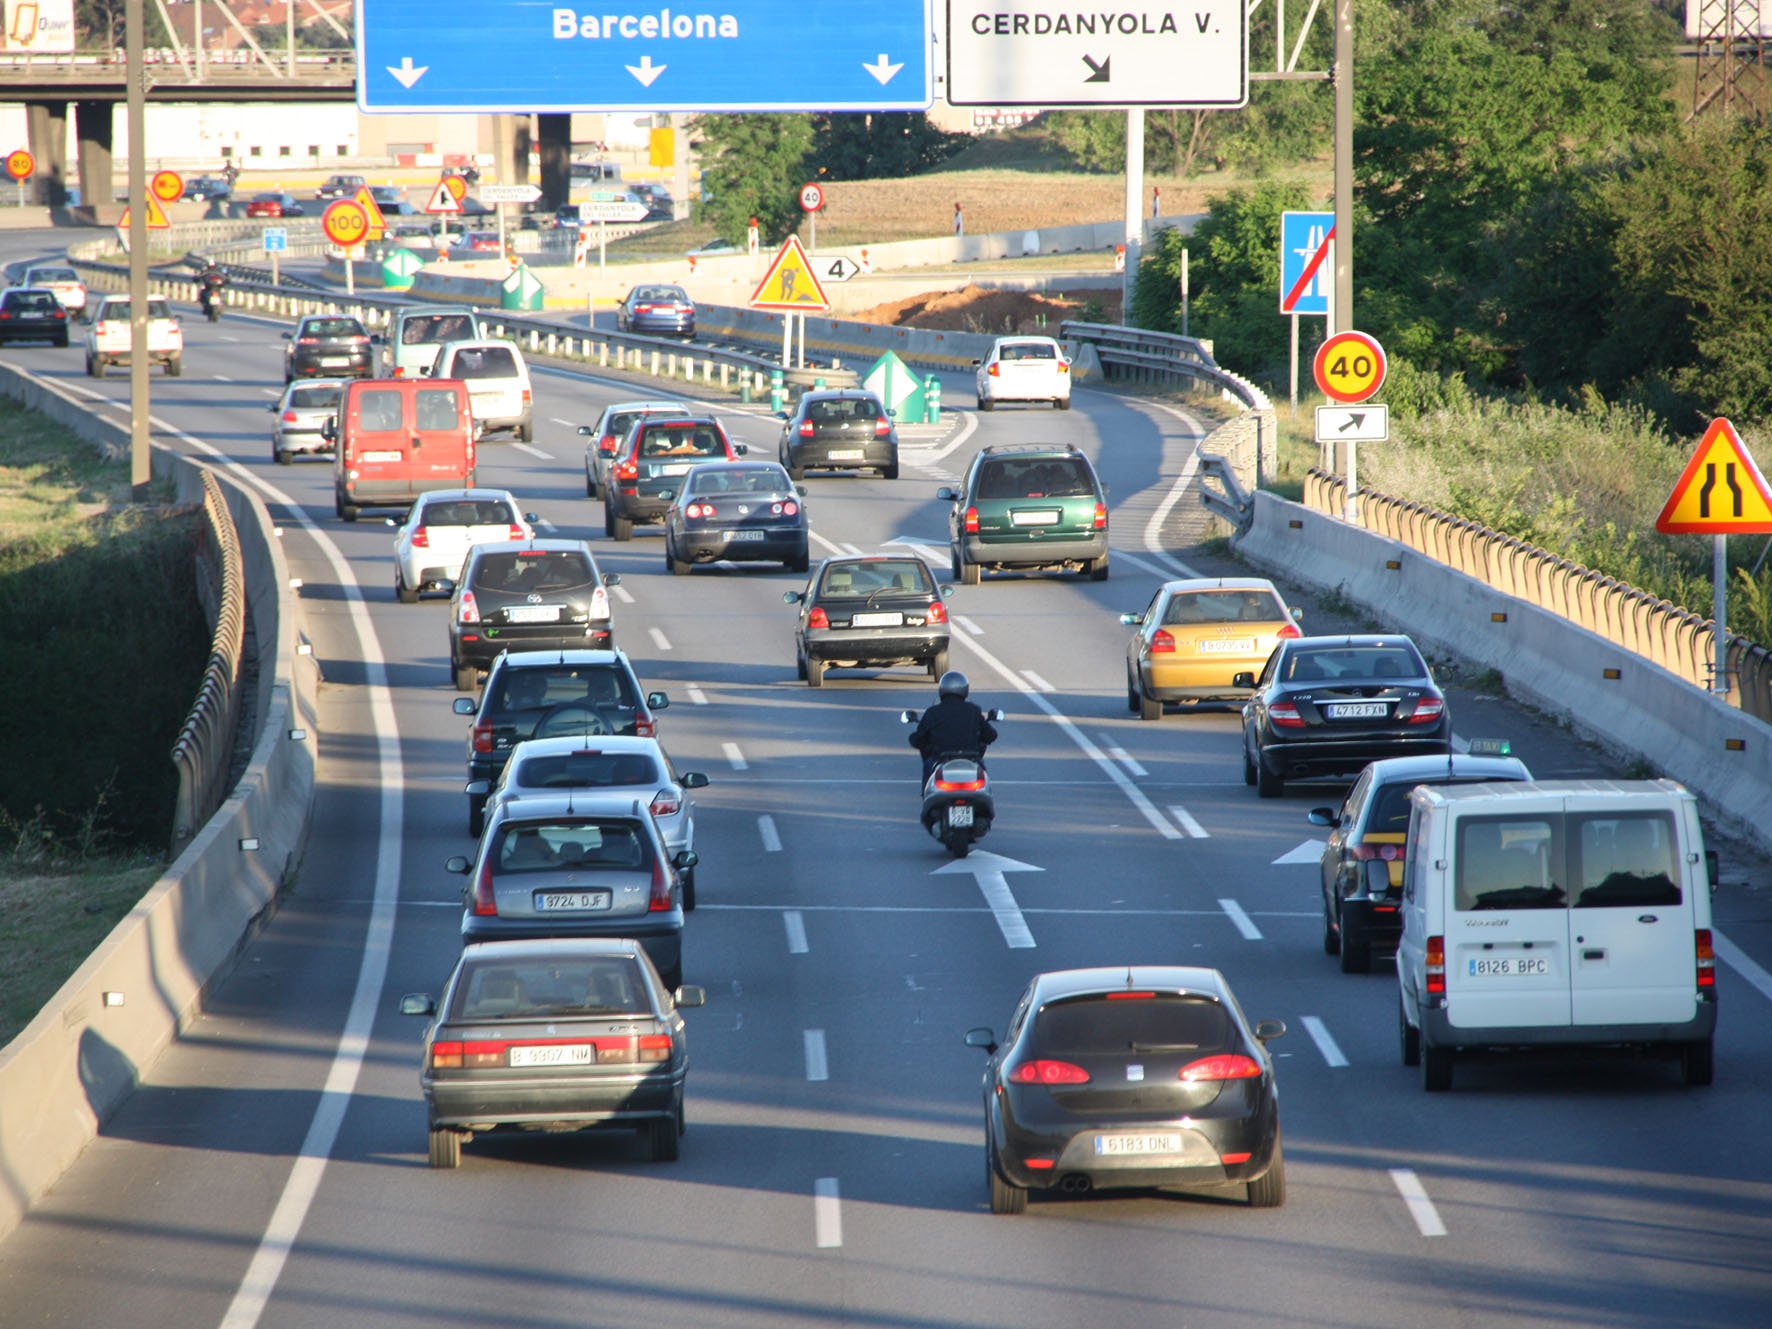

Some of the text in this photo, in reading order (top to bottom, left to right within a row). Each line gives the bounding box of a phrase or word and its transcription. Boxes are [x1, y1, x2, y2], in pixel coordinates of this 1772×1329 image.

[553, 8, 738, 39] Barcelona
[971, 12, 1220, 35] CERDANYOLA V.
[804, 192, 819, 202] 40
[330, 216, 362, 231] 100
[828, 259, 845, 278] 4
[1330, 355, 1371, 378] 40
[1335, 703, 1385, 717] 4712 FXN
[545, 894, 602, 908] 9724 DJF
[1477, 959, 1546, 974] 8126 BPC
[513, 1051, 521, 1063] B
[1108, 1135, 1173, 1153] 6183 DNL
